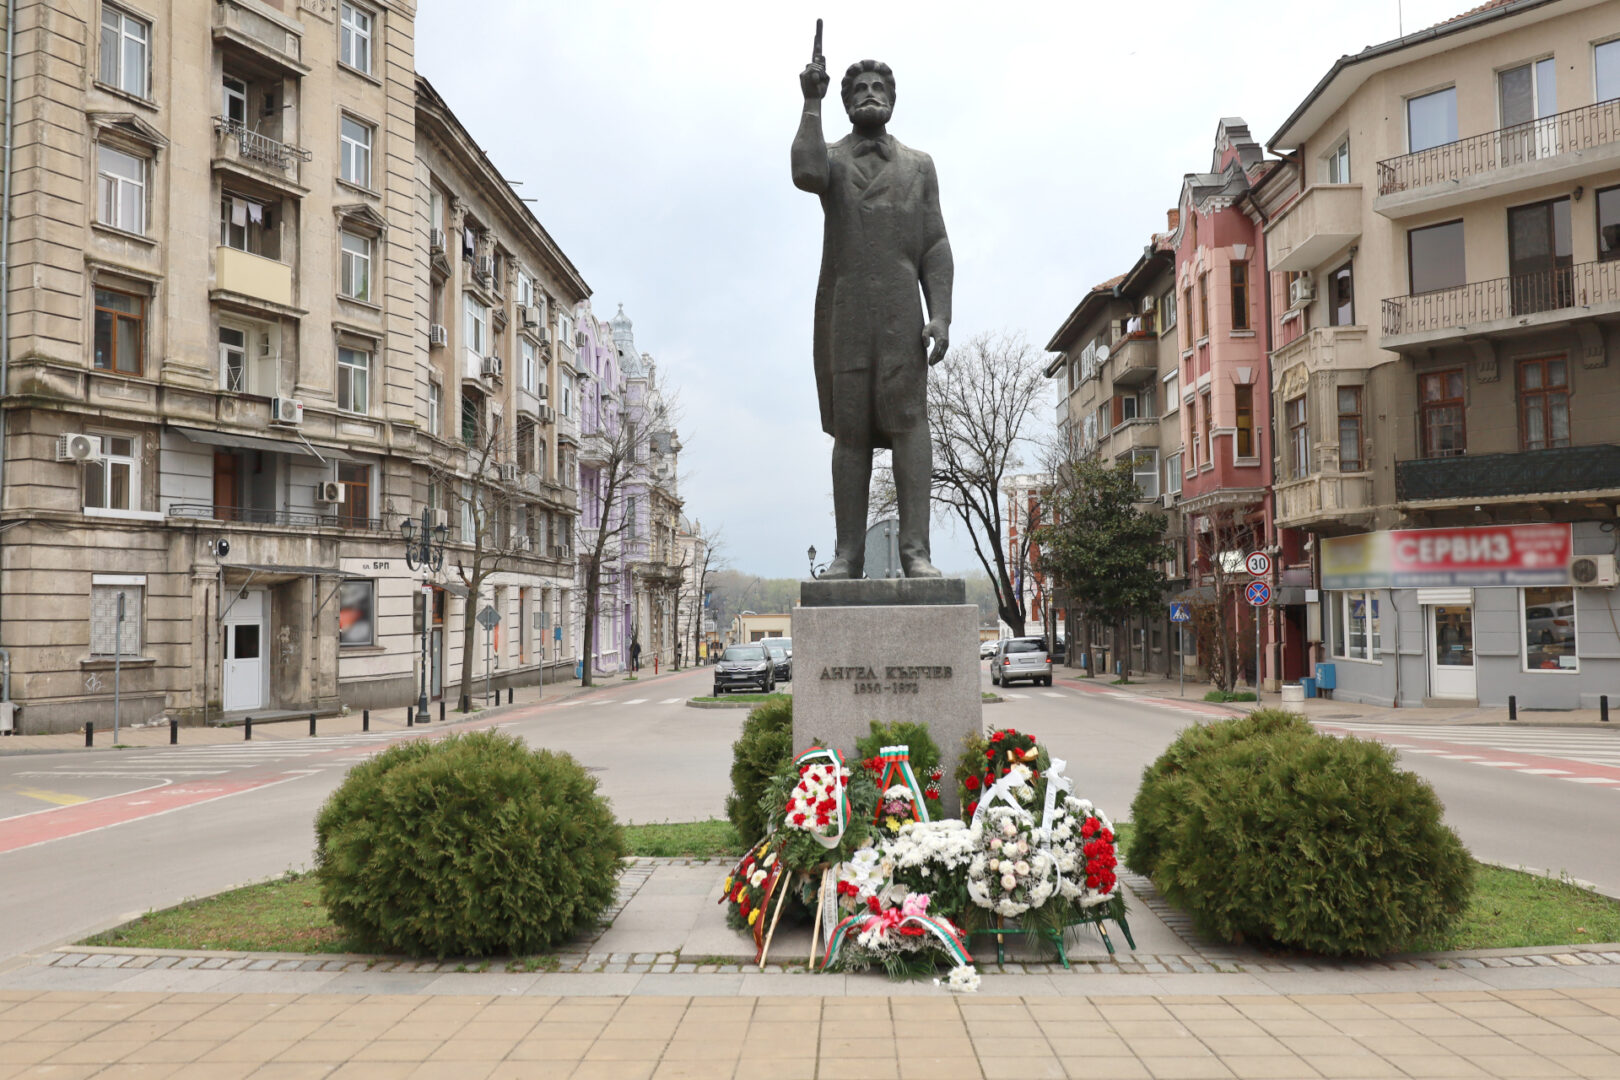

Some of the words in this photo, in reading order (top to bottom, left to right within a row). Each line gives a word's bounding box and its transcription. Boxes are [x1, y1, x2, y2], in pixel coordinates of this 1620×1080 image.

[1397, 533, 1511, 564] СЕРВИЗ
[373, 561, 390, 570] БРП
[1251, 557, 1266, 570] 30
[820, 666, 877, 680] АНГЕЛ
[885, 666, 952, 679] КЪНЧЕВ
